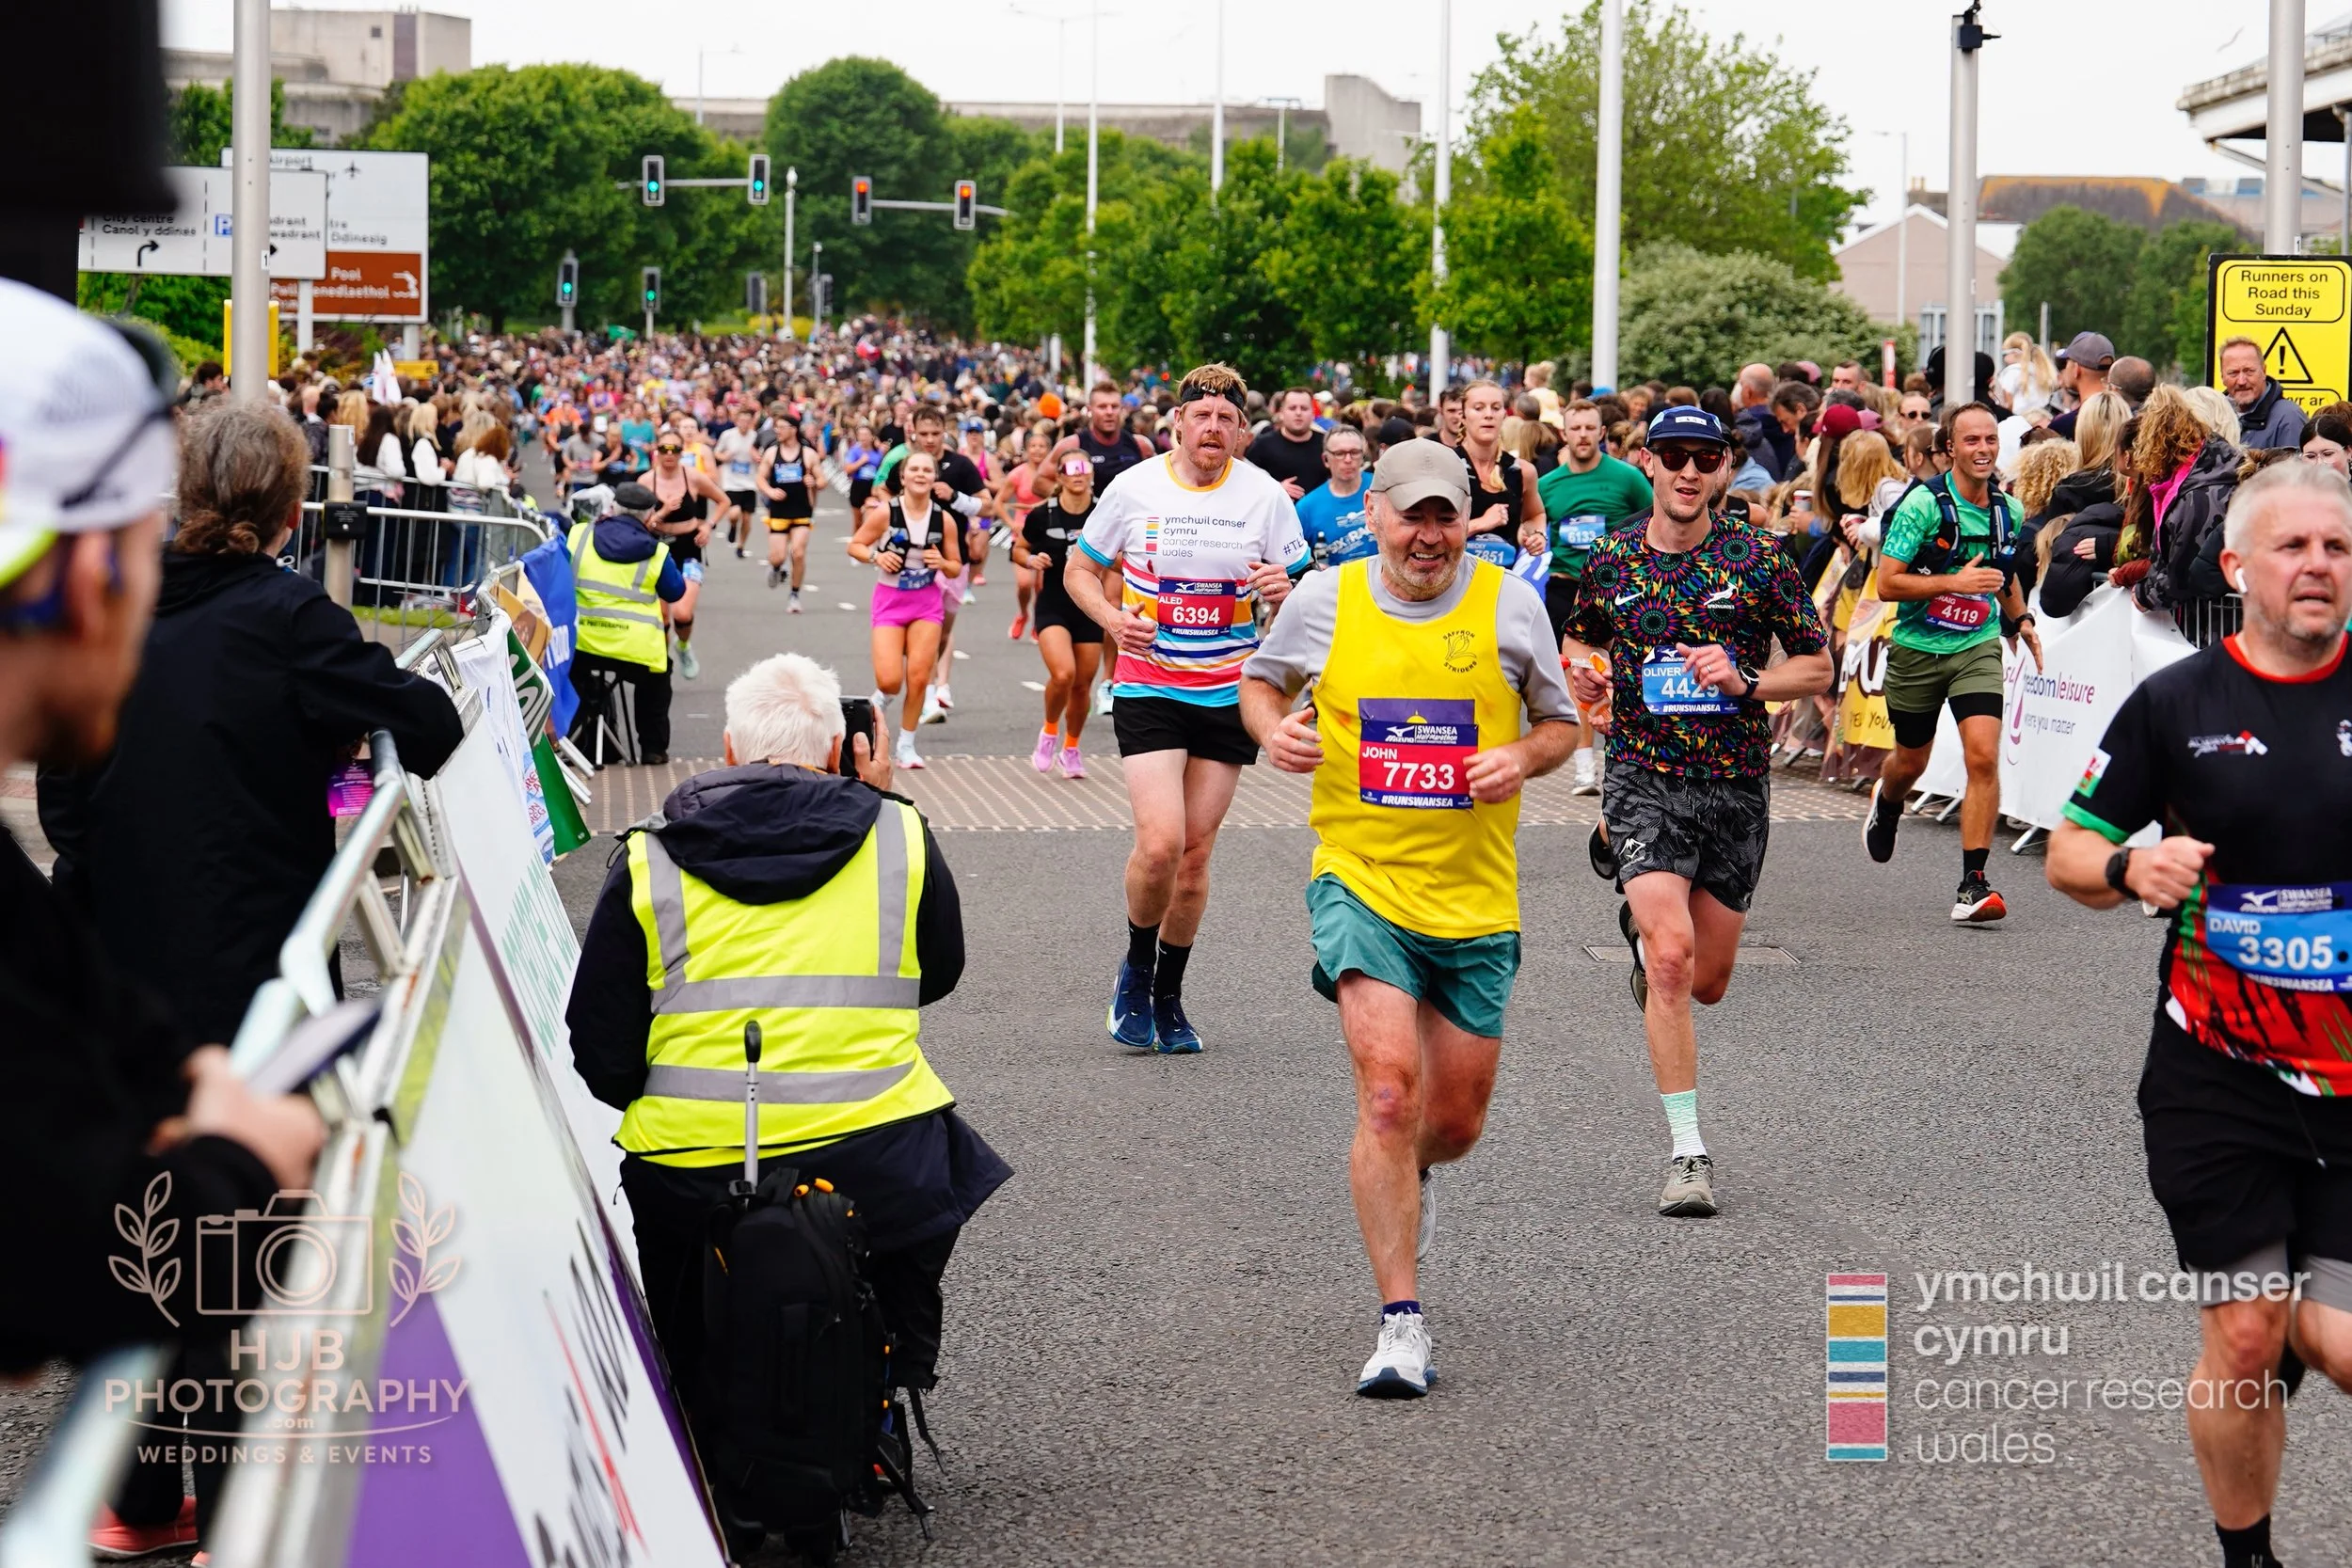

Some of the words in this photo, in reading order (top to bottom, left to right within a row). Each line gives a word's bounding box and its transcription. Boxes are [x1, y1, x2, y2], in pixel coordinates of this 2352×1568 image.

[103, 213, 128, 224] City
[270, 217, 307, 226] drant
[103, 225, 139, 235] Canol
[143, 228, 151, 237] y
[330, 266, 363, 281] Pool
[2241, 270, 2304, 282] Runners
[2309, 273, 2328, 282] on
[312, 286, 389, 298] enedlaethol
[2249, 287, 2287, 298] Road
[2293, 287, 2320, 299] this
[2255, 304, 2312, 318] Sunday
[2310, 397, 2325, 406] ar
[1165, 515, 1210, 526] ymchwil
[1212, 518, 1246, 529] canser
[1164, 527, 1198, 536] cymru
[1163, 538, 1199, 546] cancer
[1200, 539, 1243, 549] research
[1567, 531, 1596, 545] 6133
[1162, 547, 1193, 558] wales
[1475, 550, 1504, 564] 7851
[1158, 596, 1183, 606] ALED
[1935, 595, 1957, 605] RAIG
[1172, 606, 1220, 625] 6394
[1941, 605, 1979, 624] 4119
[1442, 629, 1475, 641] SAFFRON
[1444, 660, 1477, 673] STRIDERS
[1643, 667, 1682, 677] OLIVER
[1662, 704, 1721, 712] #RUNSWANSEA
[1416, 725, 1457, 736] SWANSEA
[1362, 746, 1398, 760] JOHN
[1383, 762, 1455, 790] 7733
[1381, 795, 1454, 807] #RUNSWANSEA
[2281, 887, 2332, 900] SWANSEA
[2210, 917, 2262, 935] DAVID
[2238, 936, 2334, 971] 3305
